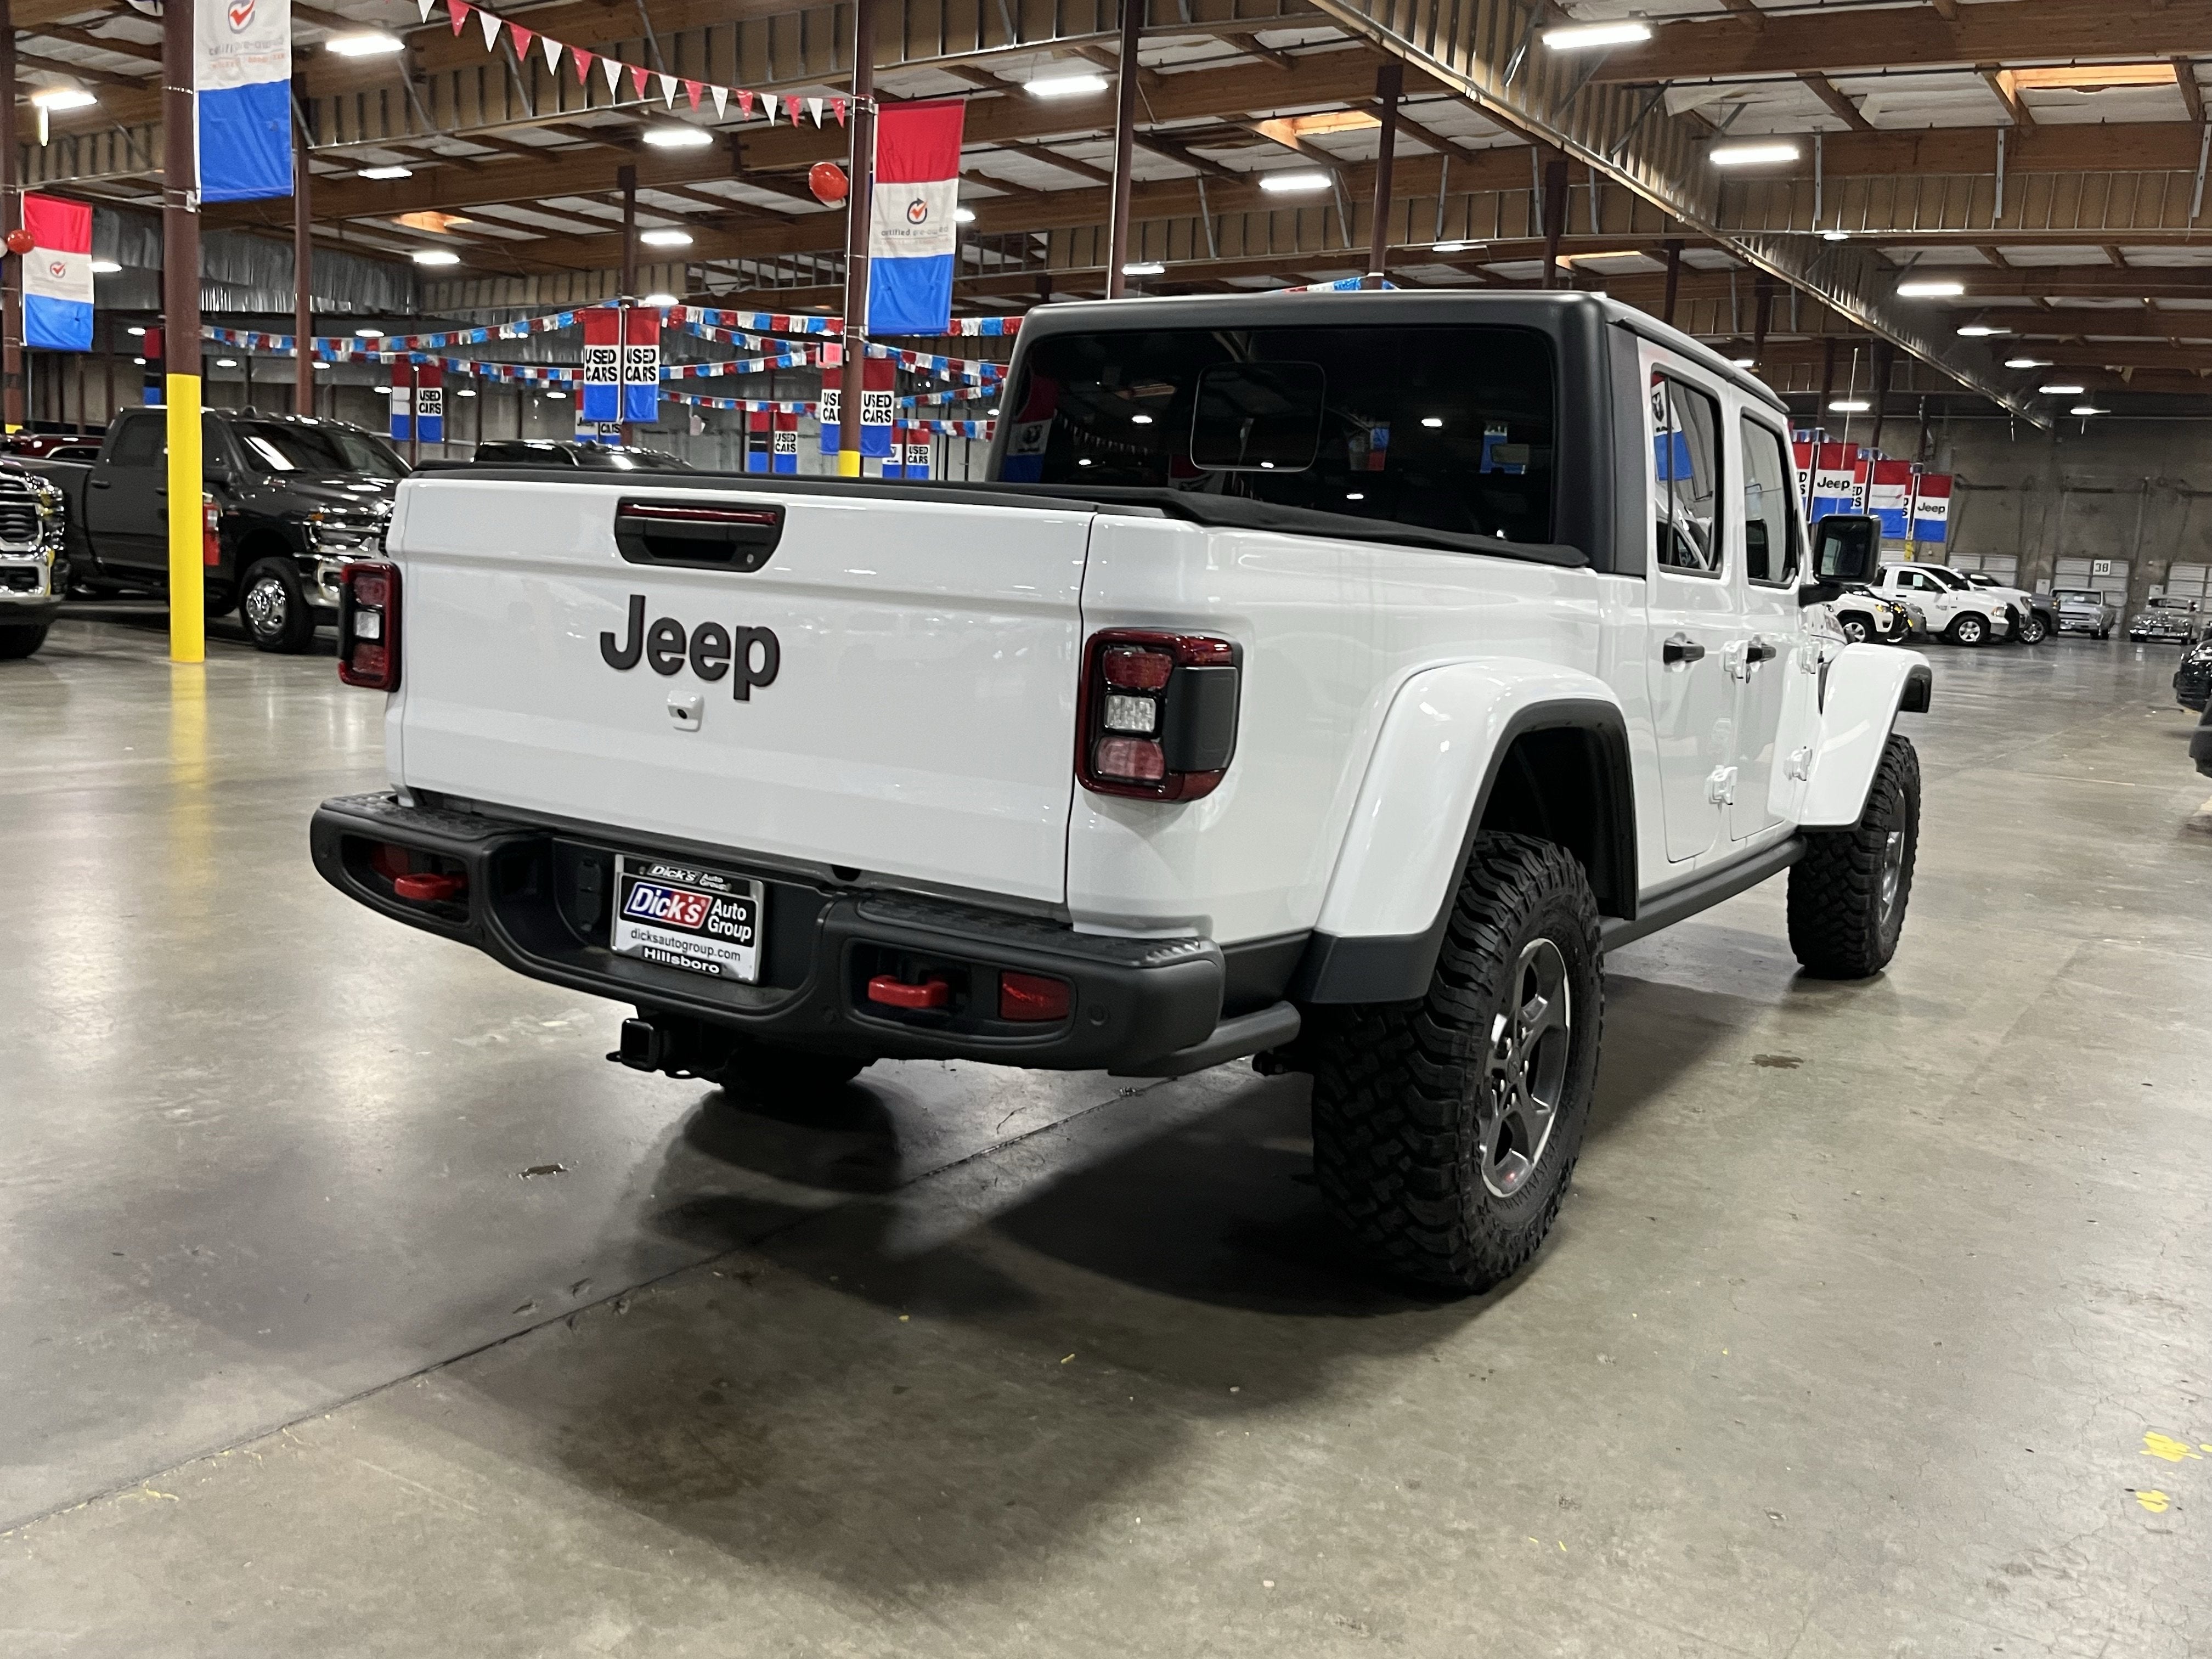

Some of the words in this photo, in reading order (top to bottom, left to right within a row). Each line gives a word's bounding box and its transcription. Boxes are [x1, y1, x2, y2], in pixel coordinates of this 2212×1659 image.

[585, 348, 617, 364] USED
[627, 348, 656, 364] USED
[585, 365, 618, 382] CARS
[625, 366, 656, 382] CARS
[420, 390, 441, 401] USED
[864, 393, 892, 408] USED
[419, 402, 441, 414] CARS
[862, 409, 891, 423] CARS
[776, 433, 796, 442] USED
[909, 446, 928, 454] USED
[908, 455, 928, 464] CARS
[1817, 477, 1850, 491] Jeep
[1917, 502, 1945, 514] Jeep
[2095, 563, 2109, 572] 38
[600, 594, 781, 701] Jeep
[652, 866, 696, 882] Dick's
[631, 887, 702, 923] Dick's
[711, 899, 747, 921] Auto
[708, 916, 752, 942] Group
[631, 928, 741, 961] dicksautogroup.com
[644, 947, 720, 974] Hillsboro
